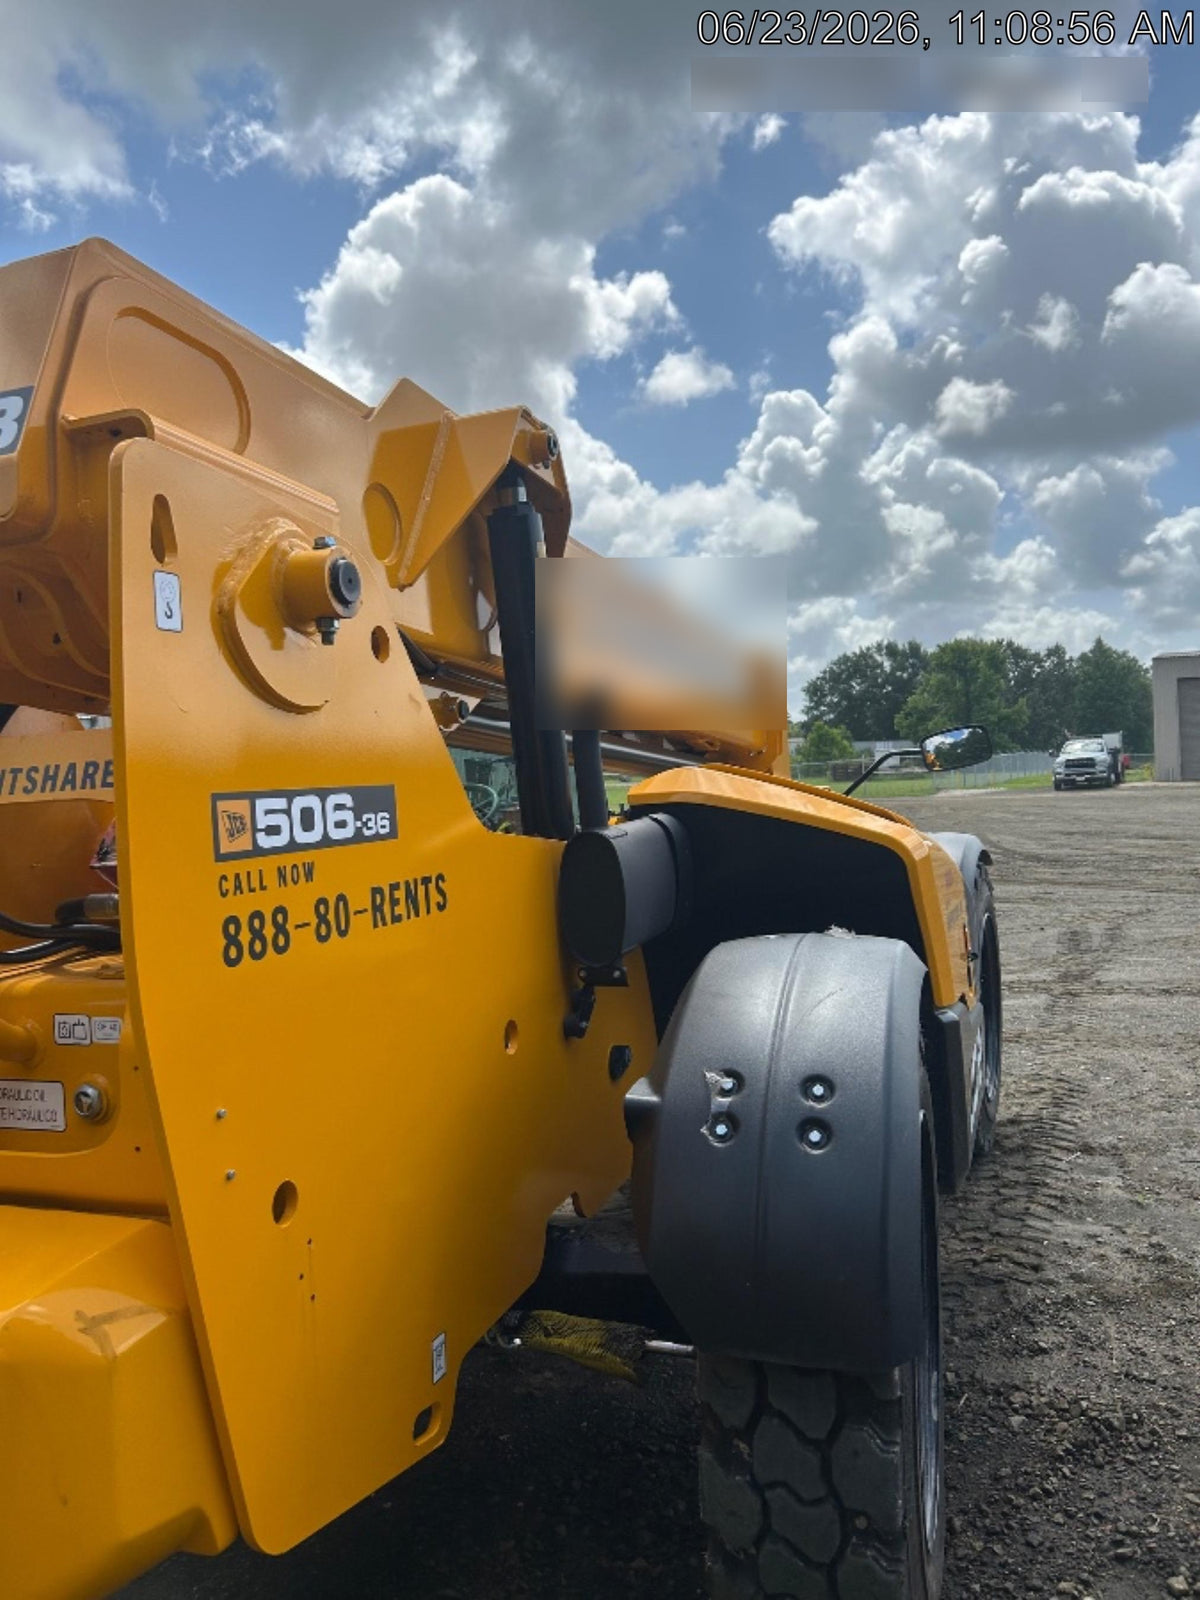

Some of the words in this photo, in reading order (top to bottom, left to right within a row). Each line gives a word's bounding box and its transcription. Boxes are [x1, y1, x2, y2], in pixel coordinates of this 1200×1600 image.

[219, 869, 267, 898] CALL
[277, 861, 315, 888] NOW
[222, 872, 448, 968] 888-80-RENTS
